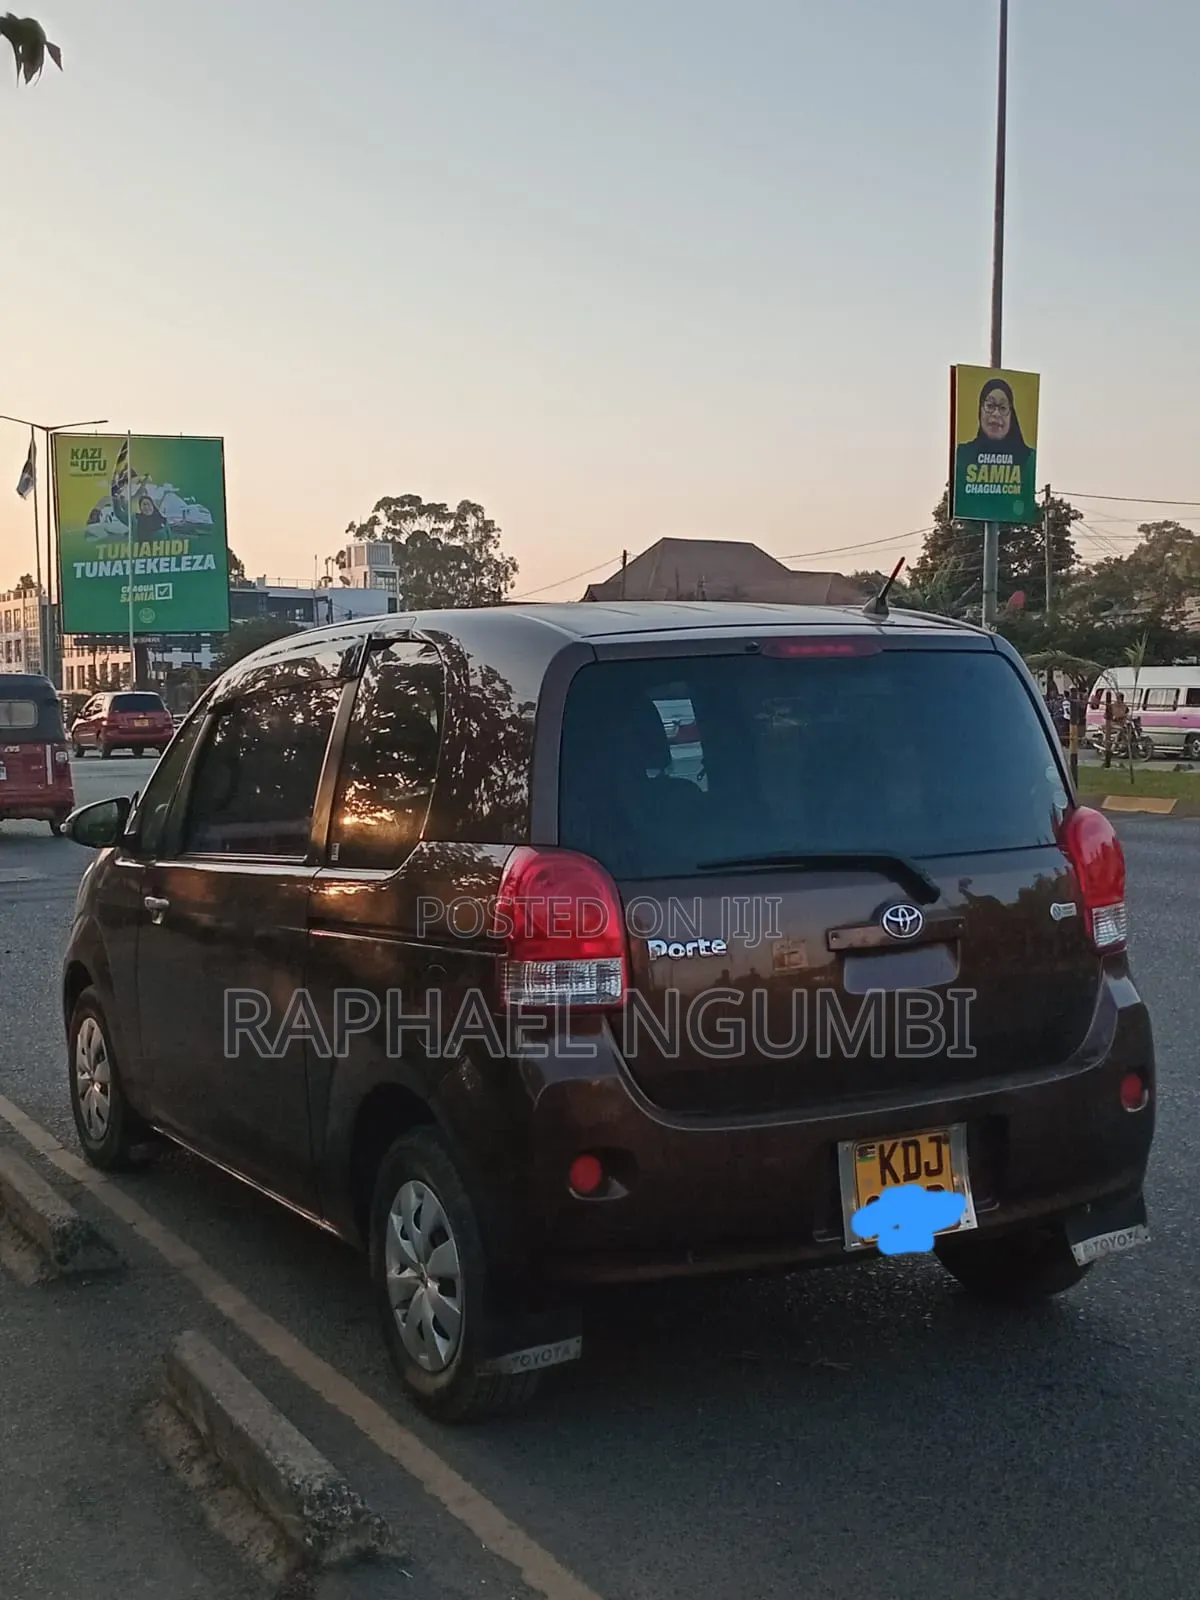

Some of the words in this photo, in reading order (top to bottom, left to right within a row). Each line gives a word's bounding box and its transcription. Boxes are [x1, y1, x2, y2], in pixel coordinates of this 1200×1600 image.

[71, 447, 102, 460] KAZI
[978, 454, 1013, 464] CHAGUA
[80, 459, 107, 472] UTU
[966, 464, 1021, 483] SAMIA
[965, 484, 1002, 494] CHAGUA
[73, 554, 216, 579] TUNATEKELEZA
[647, 938, 728, 961] Porte
[878, 1135, 944, 1186] KDJ
